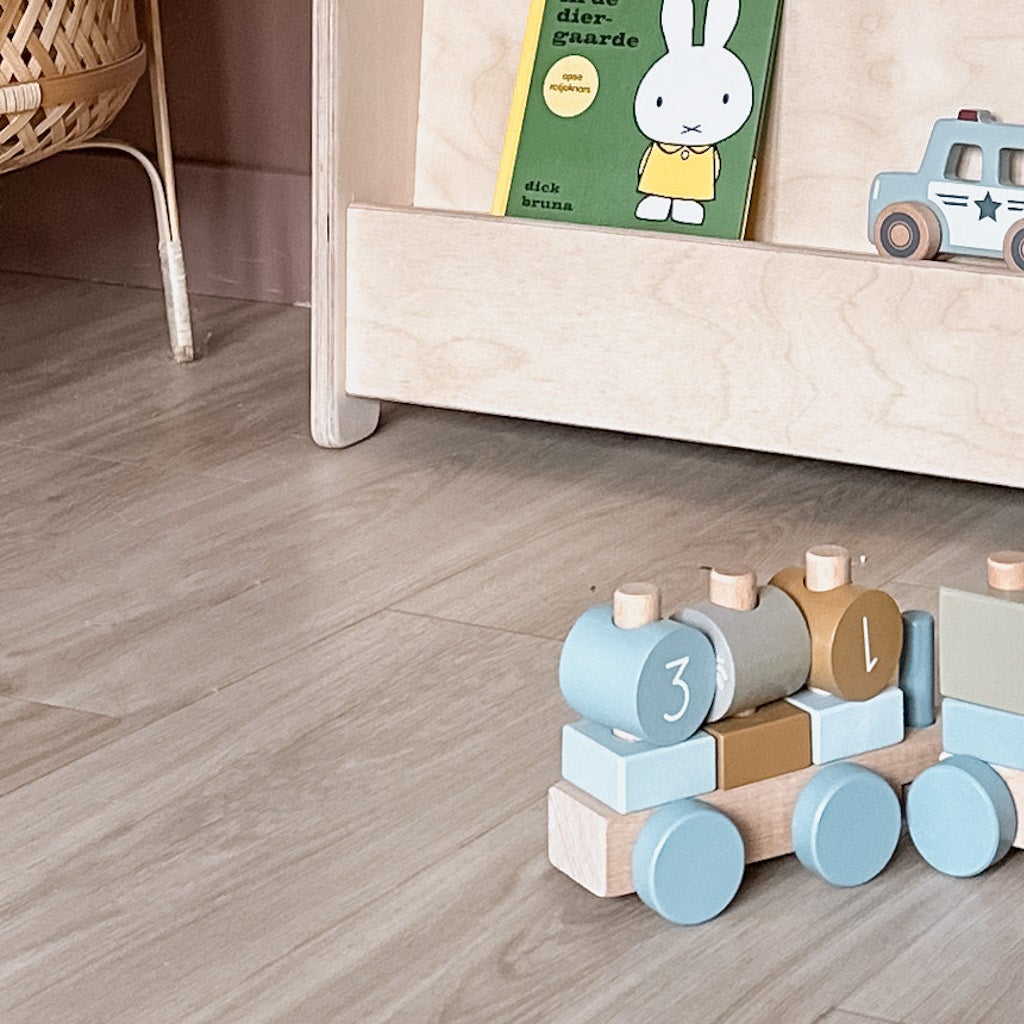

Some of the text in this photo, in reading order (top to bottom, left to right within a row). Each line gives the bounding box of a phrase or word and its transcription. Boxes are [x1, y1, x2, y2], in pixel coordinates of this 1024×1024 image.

[556, 8, 613, 25] dier-
[551, 29, 640, 48] gaarde
[524, 180, 561, 194] dick
[521, 196, 574, 212] bruna
[663, 655, 690, 723] 3
